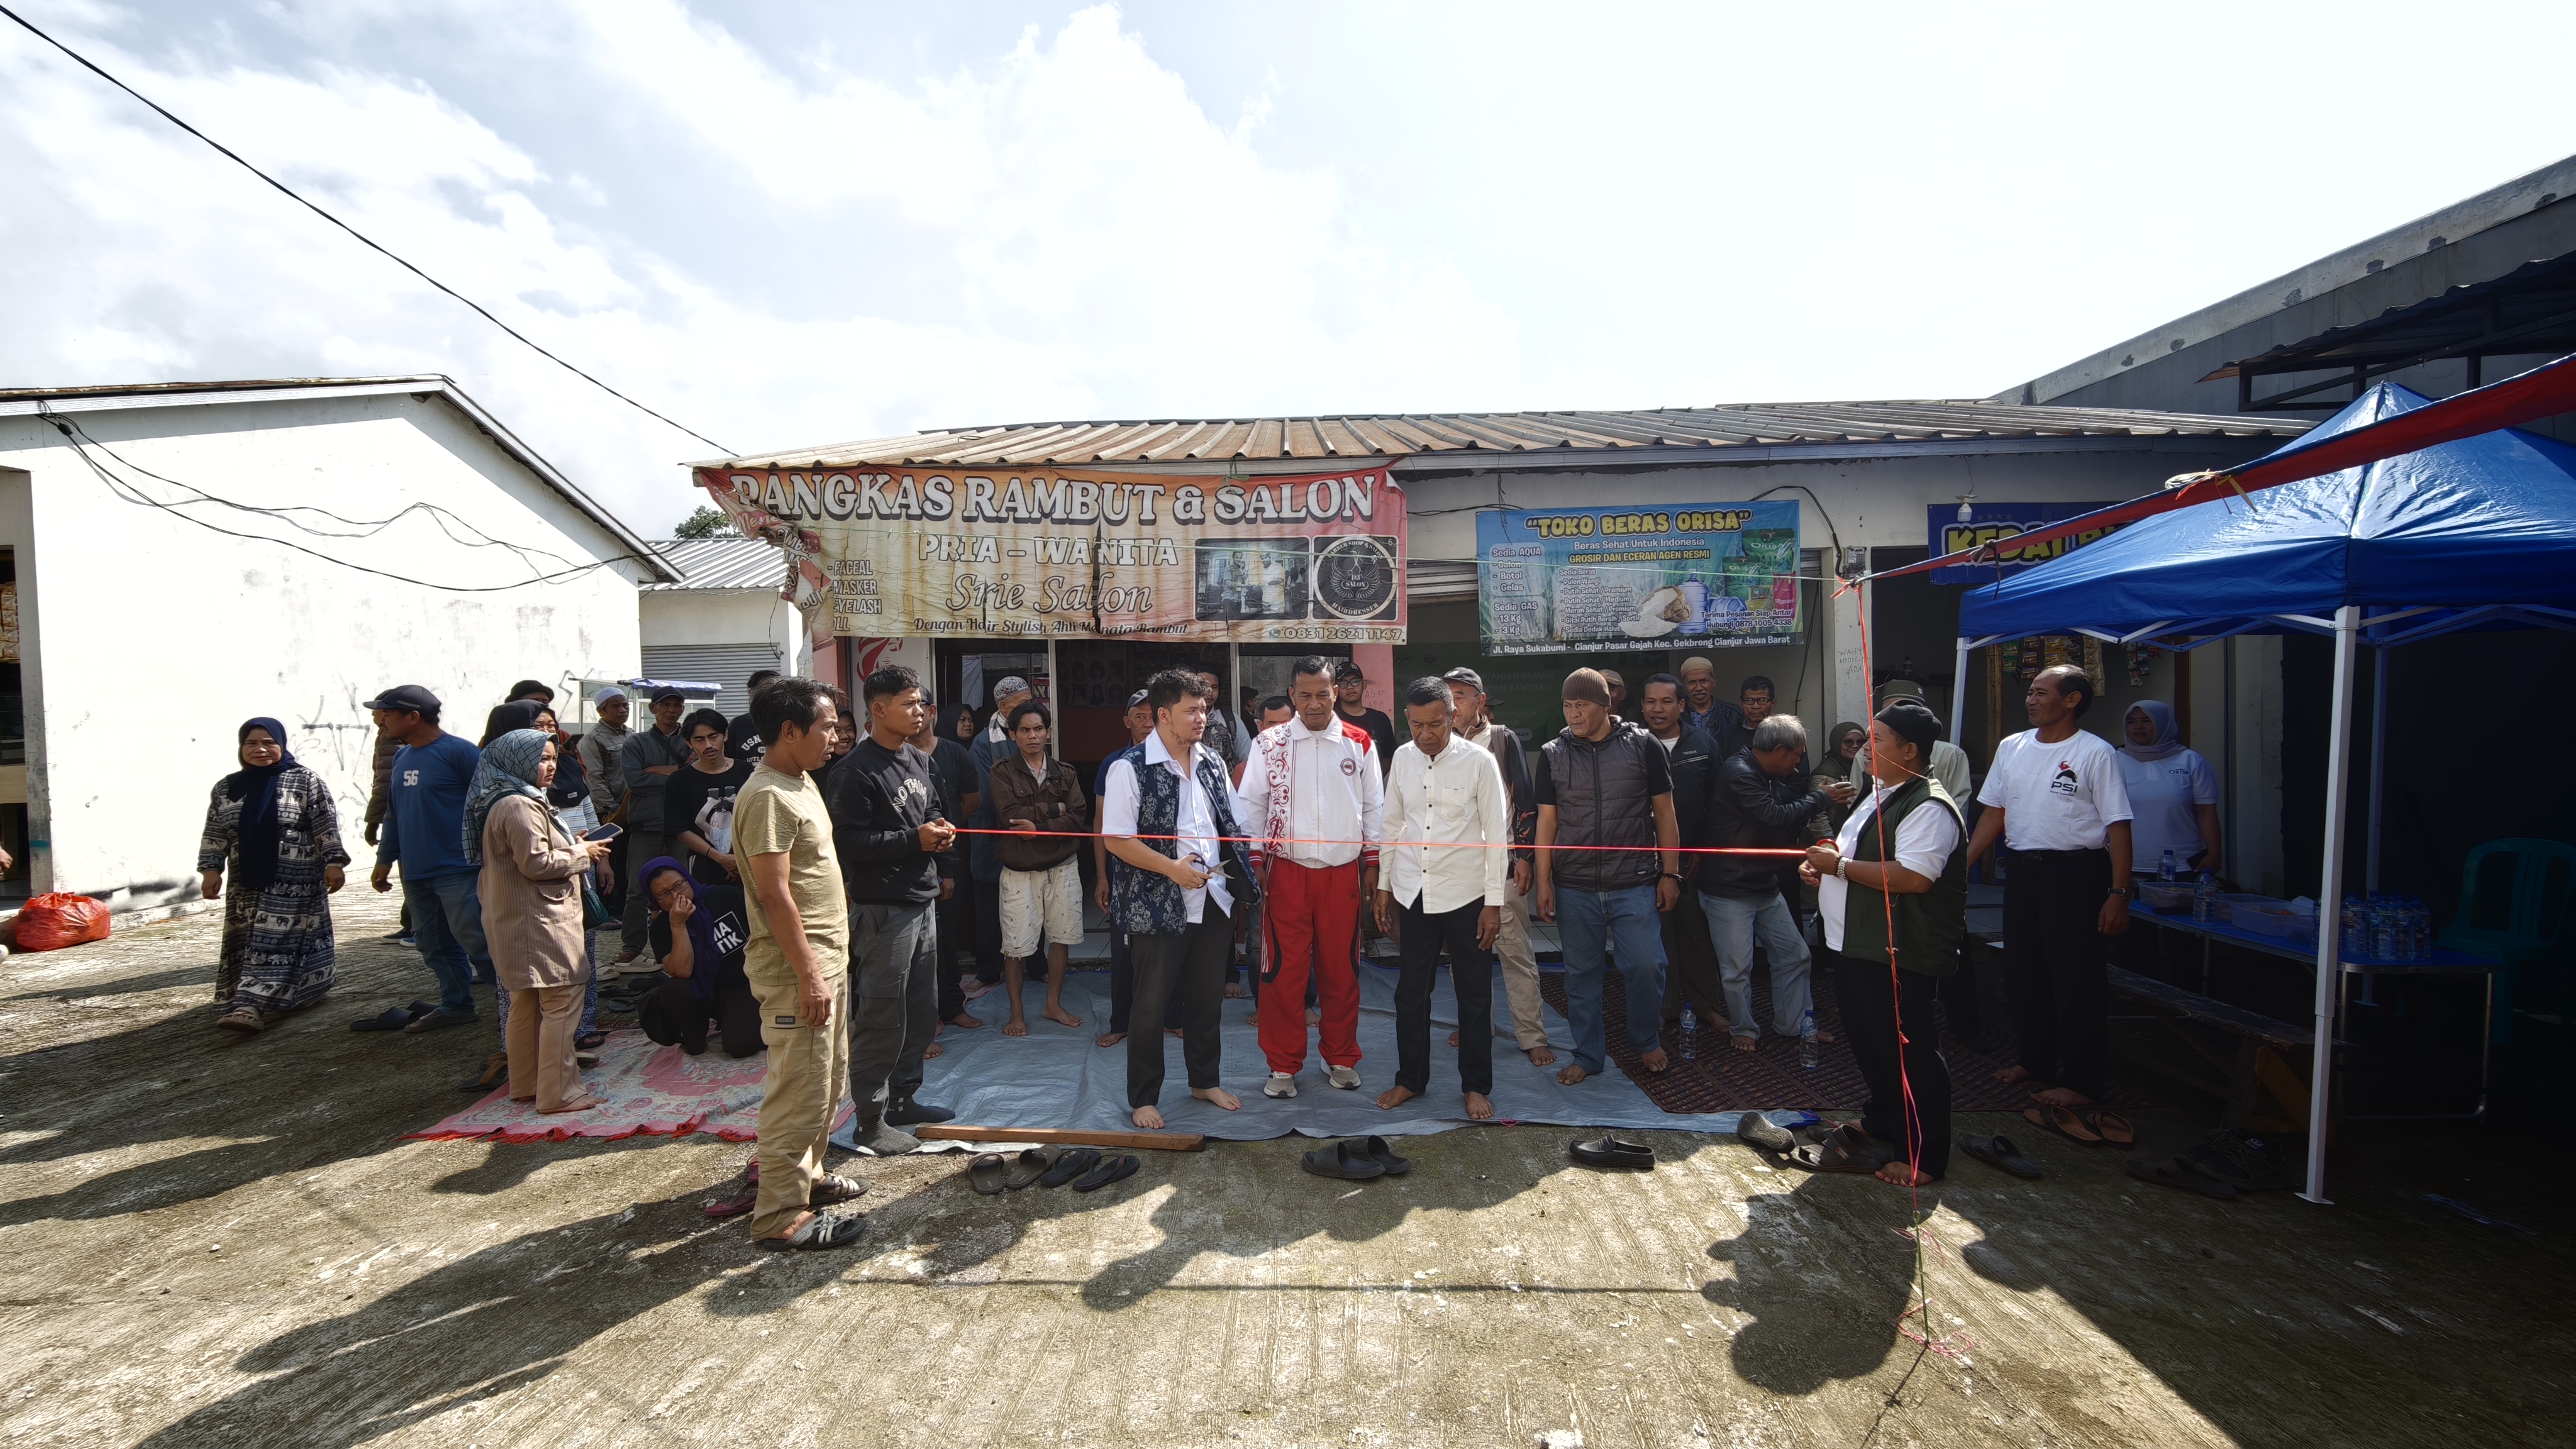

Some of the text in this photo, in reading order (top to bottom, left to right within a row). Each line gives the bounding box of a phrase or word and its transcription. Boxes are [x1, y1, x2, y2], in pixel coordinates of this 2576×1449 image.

[962, 476, 1165, 526] RAMBUT
[1173, 484, 1206, 526] &
[1214, 475, 1376, 526] SALON
[1600, 513, 1672, 536] BERAS
[919, 534, 1001, 564] PRIA
[1033, 536, 1179, 566] WANITA
[1574, 537, 1704, 550] Beras Sehat Untuk Indonesia
[1492, 547, 1541, 557] Sedia AQUA
[1569, 549, 1710, 564] GROSIR DAN ECERAN AGEN RESMI
[834, 560, 873, 575] FACEAL
[1500, 572, 1523, 580] Botol
[1582, 577, 1601, 586] Wangi
[833, 579, 879, 595] MASKER
[945, 572, 1153, 613] Srie Salon
[1501, 584, 1524, 592] Gelas
[1564, 587, 1580, 596] Putih
[1604, 595, 1630, 603] Medium
[833, 598, 882, 614] EYELASH
[1331, 602, 1379, 615] HAIRDRESSER
[1494, 602, 1538, 611] Sedia GAS
[1608, 604, 1636, 613] Premium
[1511, 614, 1521, 624] Kg
[1623, 614, 1641, 622] Sortir
[1756, 609, 1771, 618] Siap
[913, 618, 966, 632] Dengan
[967, 618, 999, 633] Hair
[1002, 619, 1047, 635] Stylish
[1050, 619, 1077, 633] Ahli
[1135, 623, 1189, 635] Rambut
[1706, 619, 1734, 629] Hubungi
[1284, 626, 1402, 640] 0831 2621 1147
[1509, 626, 1520, 636] Kg
[1493, 645, 1503, 654] Jl.
[1504, 645, 1524, 655] Raya
[1526, 643, 1566, 653] Sukabumi
[1574, 642, 1603, 652] Cianjur
[1604, 641, 1628, 650] Pasar
[1629, 640, 1653, 650] Gajah
[1654, 640, 1672, 648] Kec.
[1674, 638, 1713, 648] Gekbrong
[1714, 637, 1743, 647] Cianjur
[1744, 636, 1766, 645] Jawa
[1767, 635, 1790, 643] Barat
[402, 770, 420, 787] 56
[2051, 780, 2079, 793] PSI
